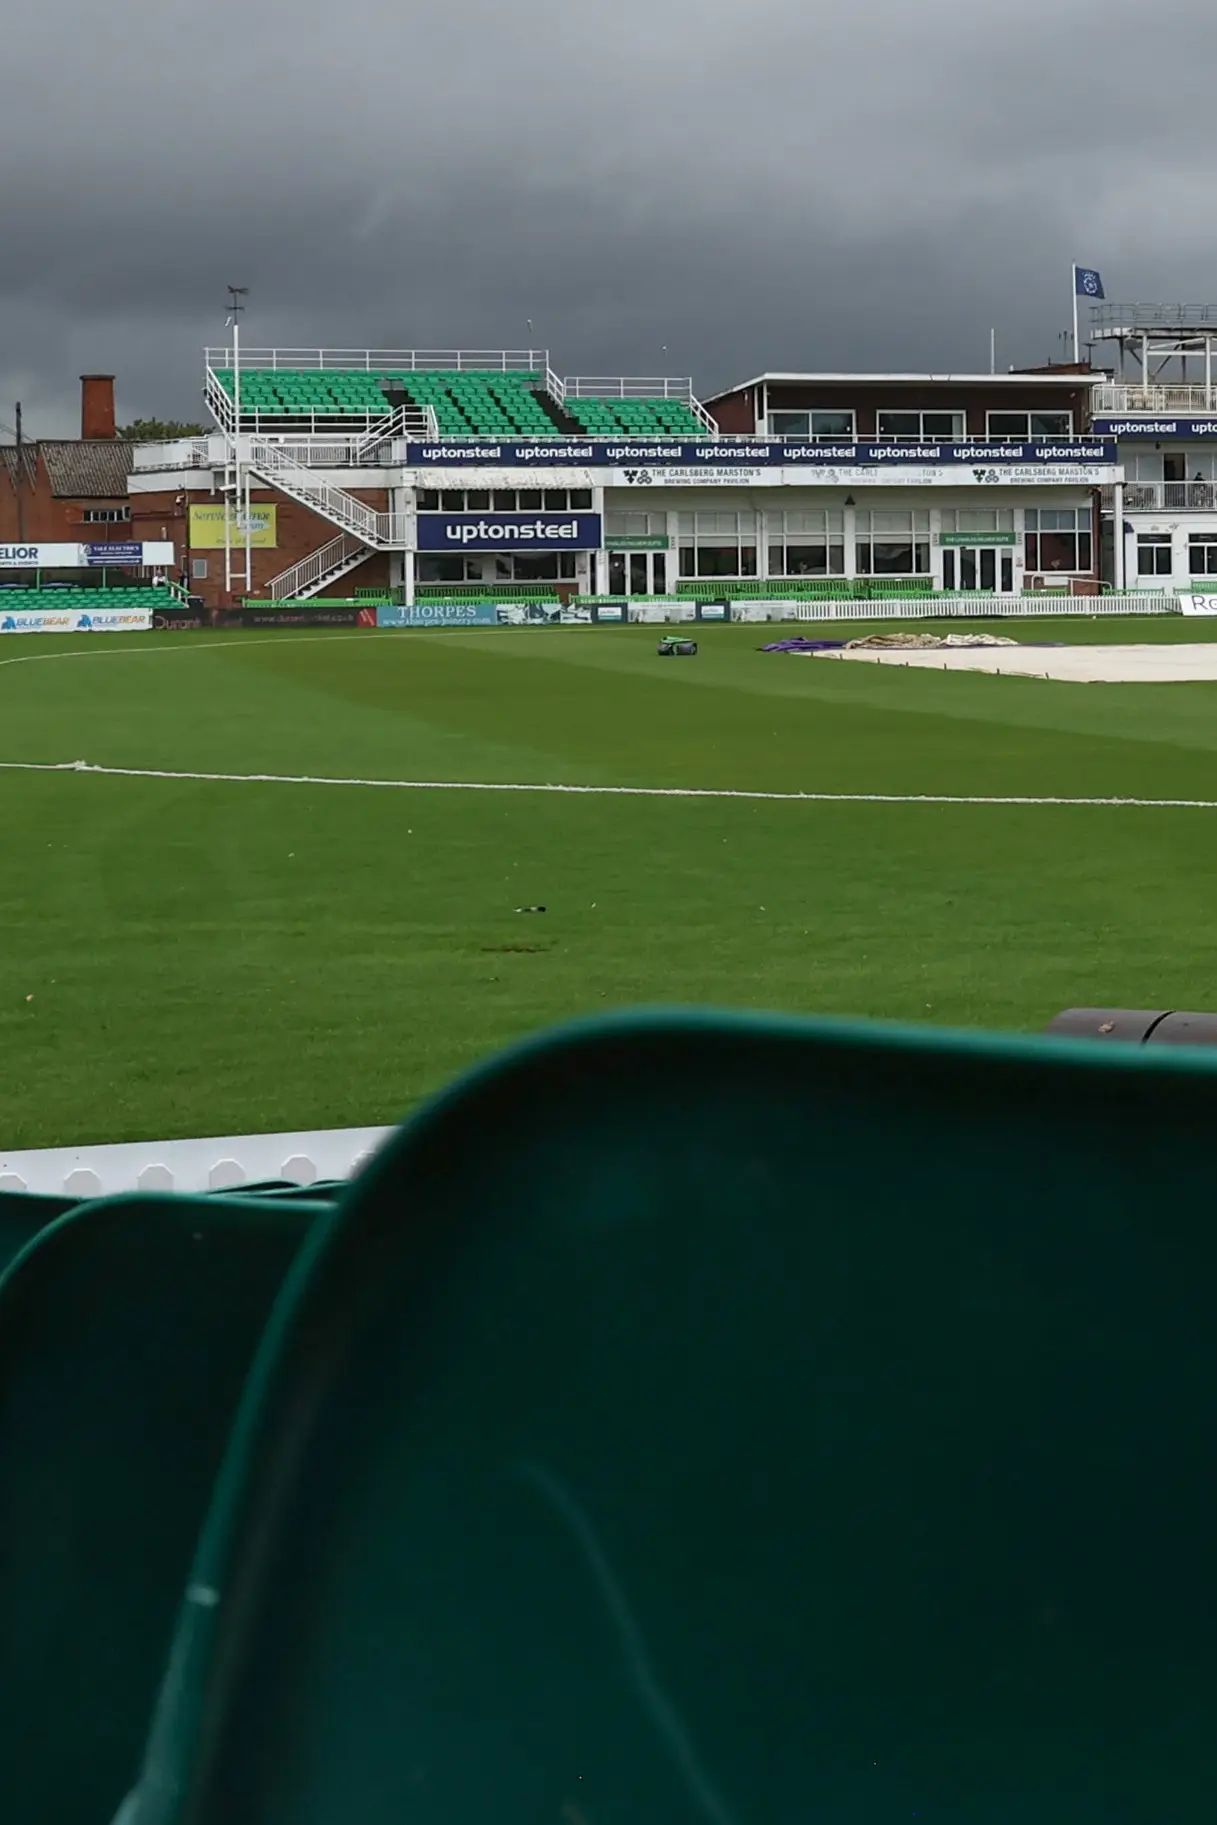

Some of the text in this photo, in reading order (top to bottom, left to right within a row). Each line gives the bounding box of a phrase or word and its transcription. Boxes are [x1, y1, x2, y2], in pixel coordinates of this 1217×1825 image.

[1109, 422, 1177, 434] uptonsteel
[422, 446, 501, 460] uptonsteel
[515, 446, 593, 460] uptonsteel
[606, 446, 682, 459] uptonsteel
[695, 446, 769, 459] uptonsteel
[783, 446, 856, 459] uptonsteel
[869, 446, 940, 459] uptonsteel
[953, 446, 1023, 459] uptonsteel
[1035, 446, 1104, 459] uptonsteel
[669, 468, 715, 476] CARLSBERG
[716, 468, 761, 476] MARSTON'S
[999, 468, 1012, 476] THE
[1014, 468, 1056, 476] CARLSBERG
[446, 520, 578, 544] uptonsteel
[398, 605, 477, 618] THORPES
